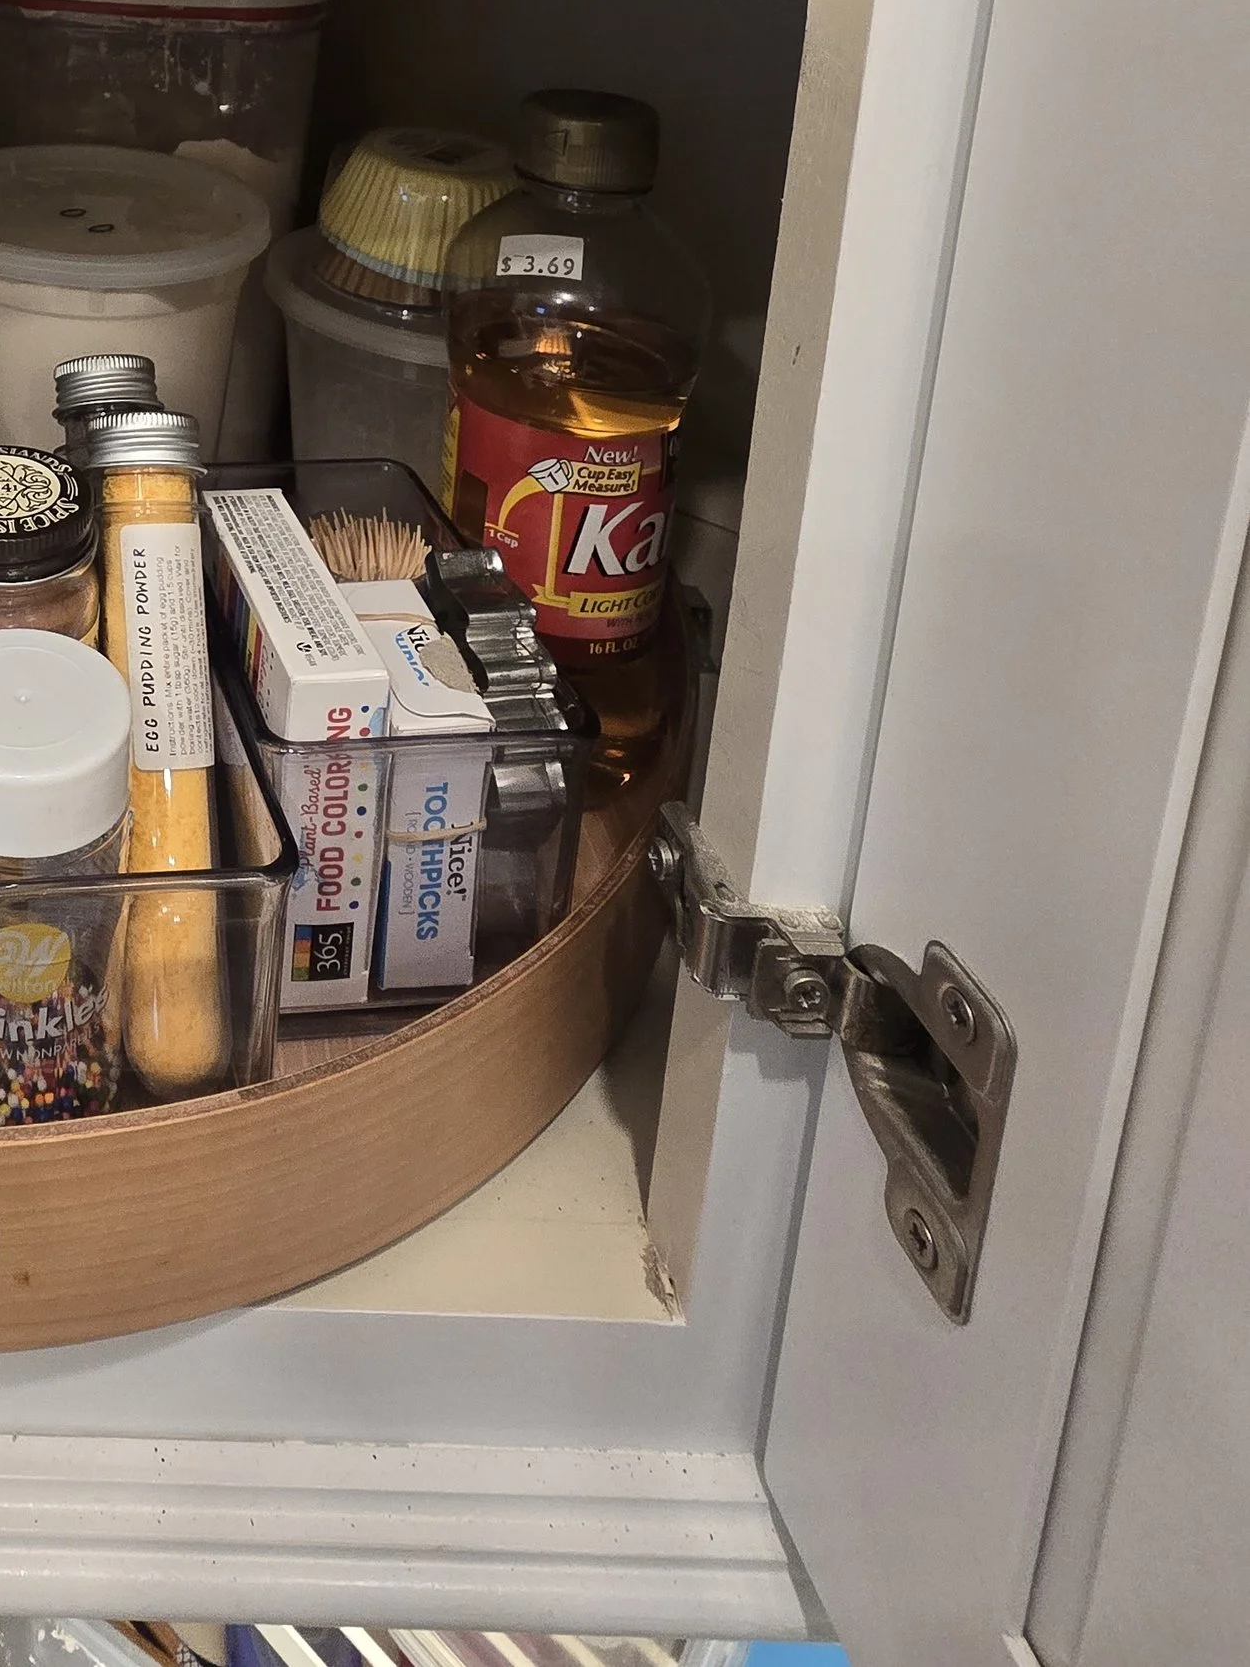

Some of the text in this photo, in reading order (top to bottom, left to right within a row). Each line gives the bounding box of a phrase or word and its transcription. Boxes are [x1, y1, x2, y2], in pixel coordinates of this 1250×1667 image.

[522, 255, 575, 276] 3.69
[584, 445, 638, 463] New!
[577, 467, 605, 480] Cup
[607, 469, 634, 481] Easy
[573, 479, 636, 493] Measure!
[20, 498, 80, 532] SPICE
[496, 532, 518, 548] Cup
[568, 502, 665, 576] Ka
[579, 597, 629, 613] LIGHT
[132, 548, 159, 752] EGG PUDDING POWDER
[589, 642, 601, 653] 16
[316, 846, 344, 912] FOOD
[317, 933, 340, 973] 365
